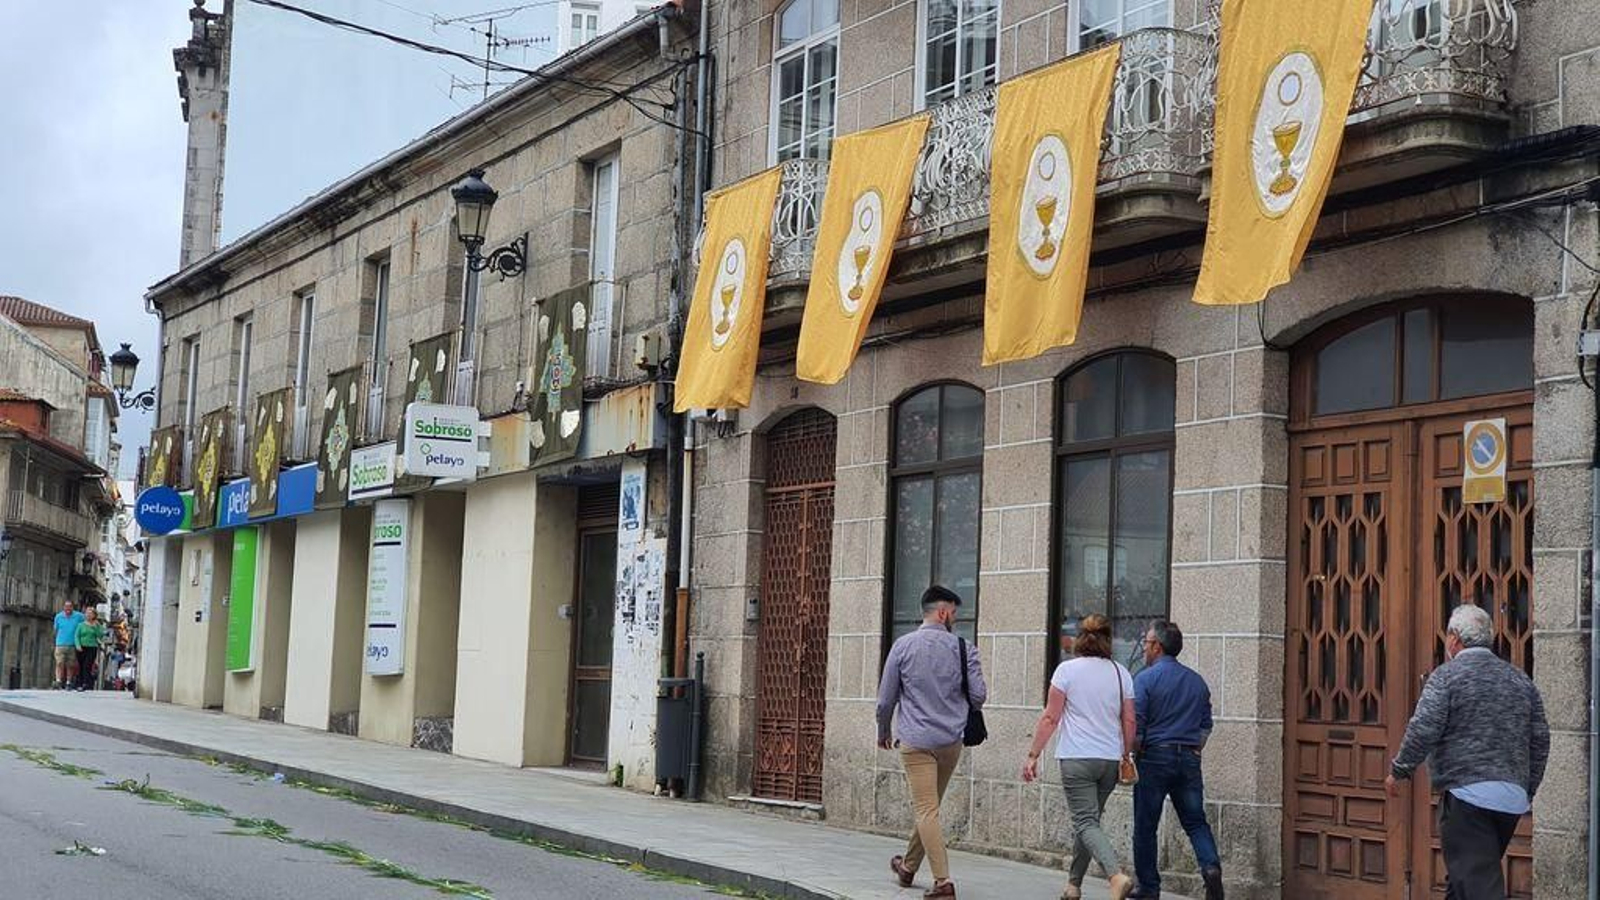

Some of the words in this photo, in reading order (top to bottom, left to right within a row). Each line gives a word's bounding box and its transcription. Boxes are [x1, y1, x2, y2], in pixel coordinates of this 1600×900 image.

[415, 418, 472, 437] Sobroso
[426, 454, 465, 467] pelayo
[352, 464, 387, 485] Sobroso
[141, 502, 181, 517] pelayo
